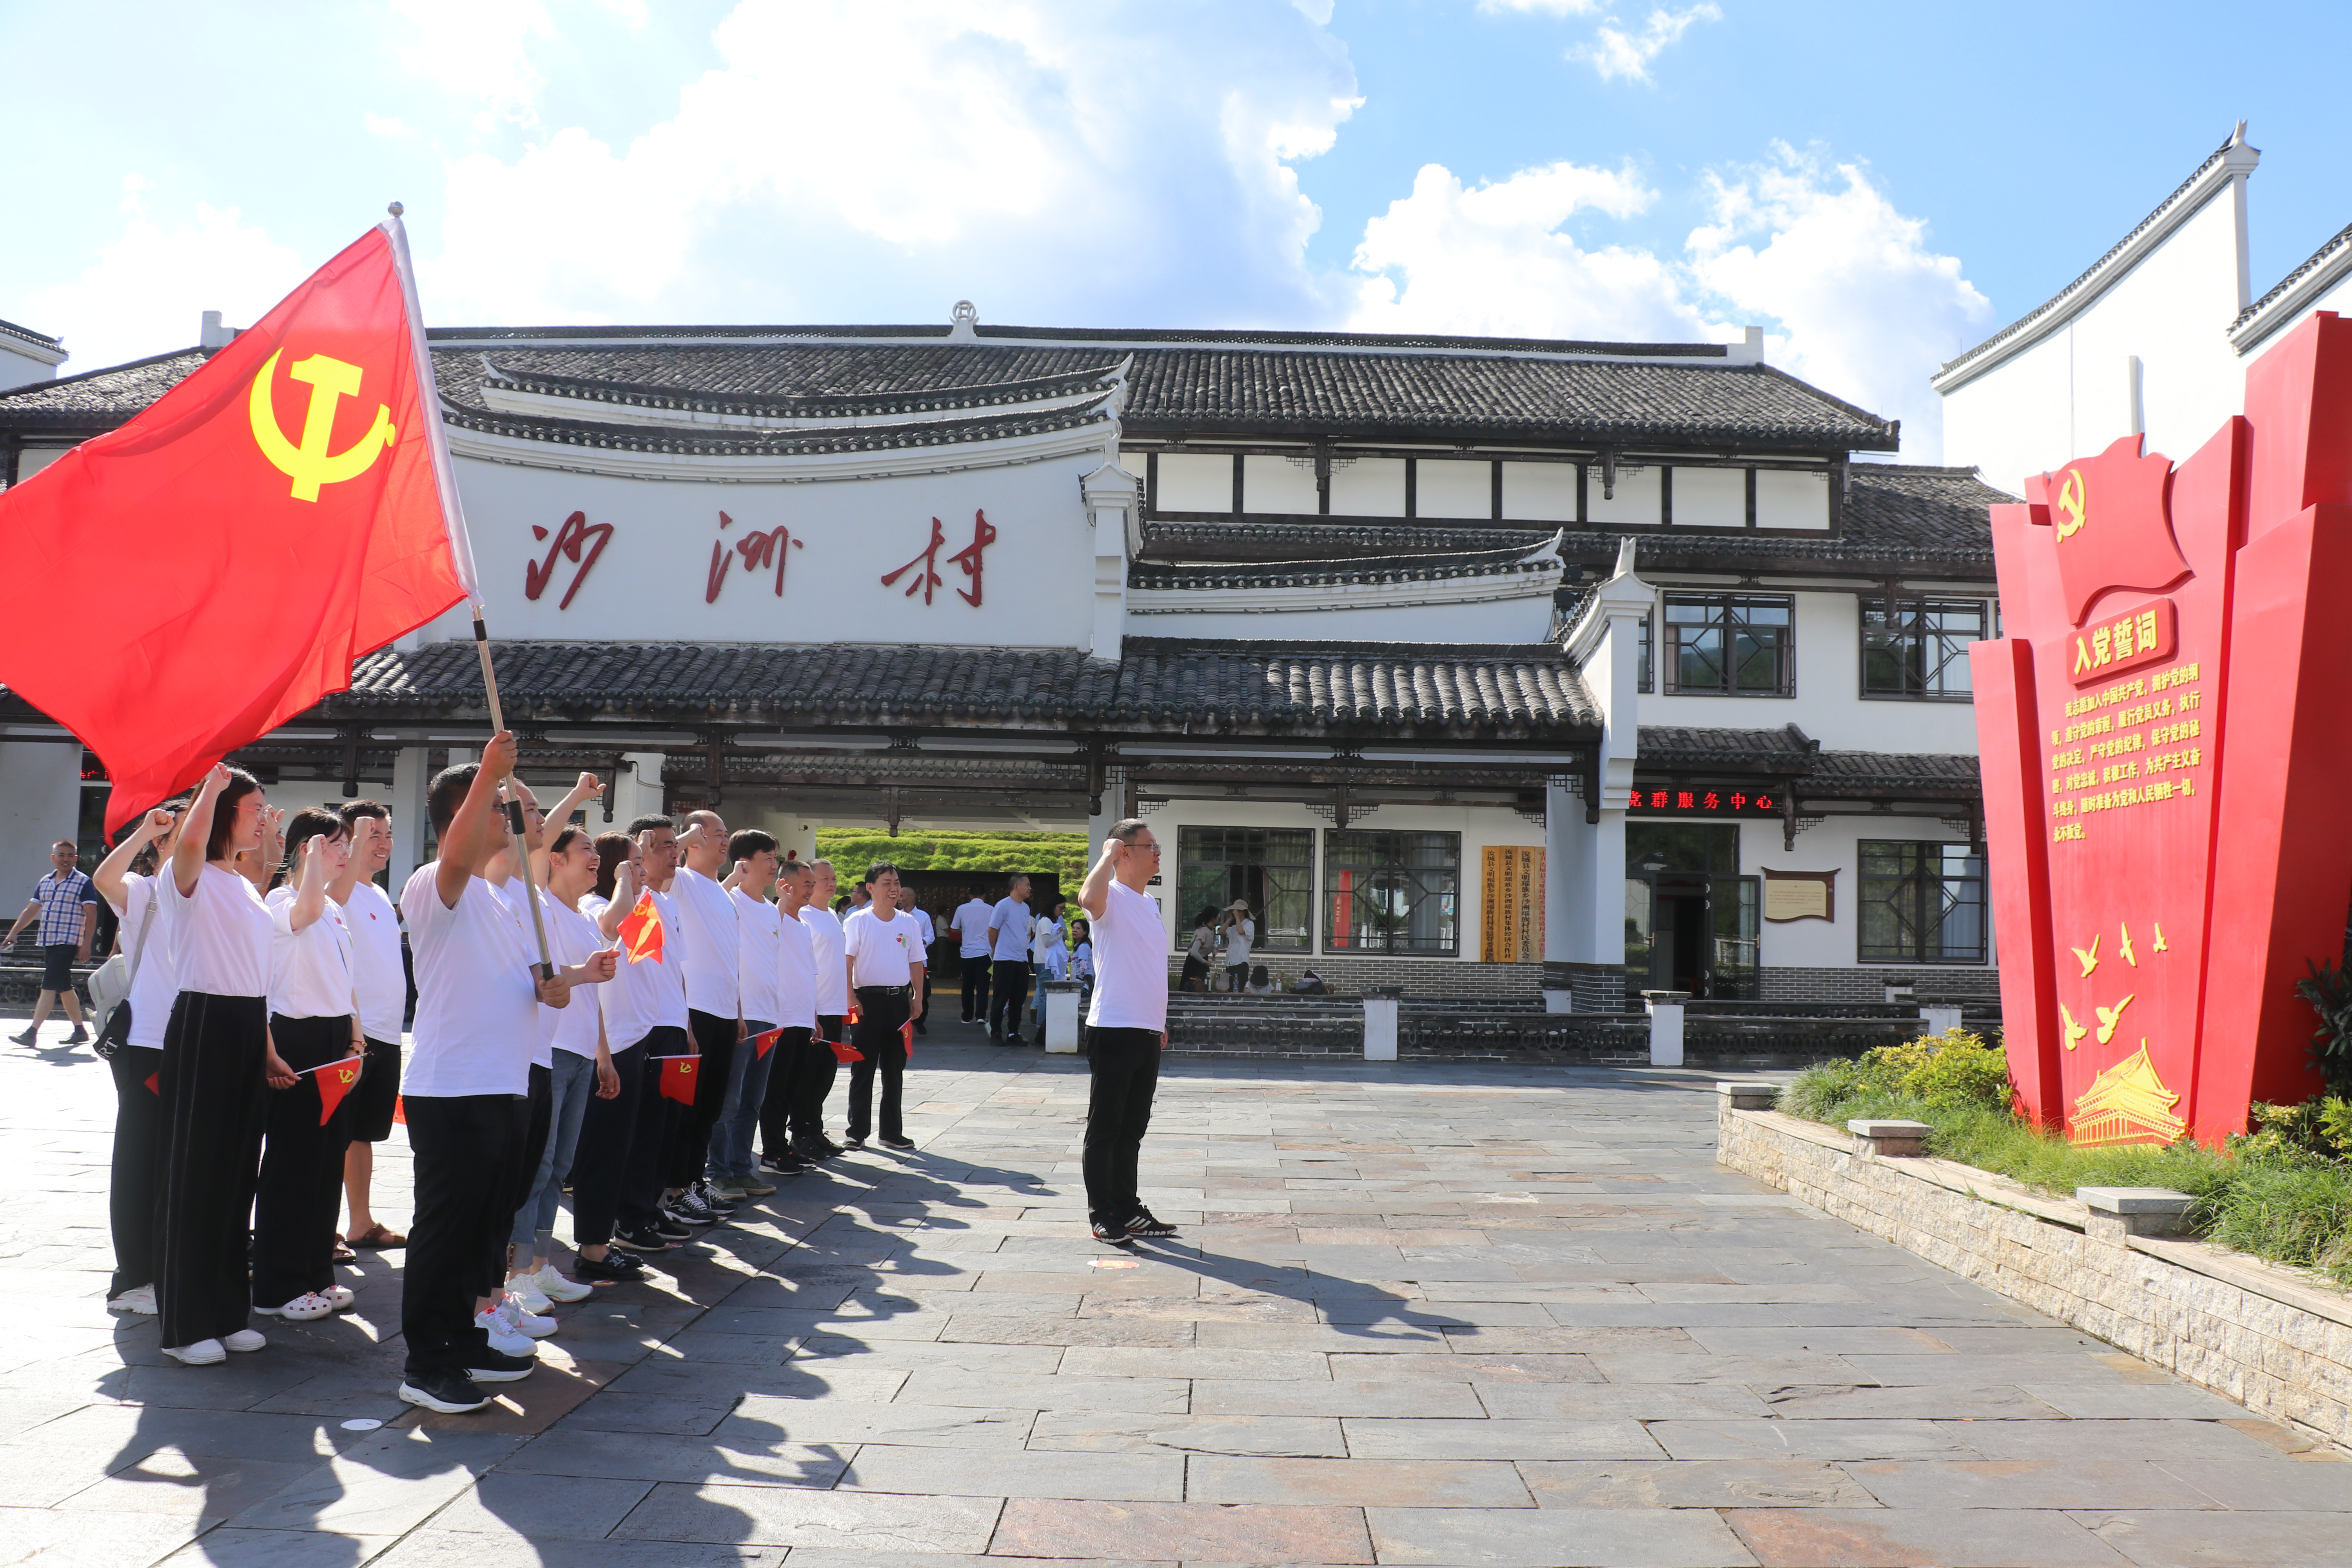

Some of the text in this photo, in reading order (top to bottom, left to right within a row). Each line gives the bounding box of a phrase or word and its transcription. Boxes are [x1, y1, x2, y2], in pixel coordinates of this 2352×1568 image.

[525, 508, 996, 610] 沙洲村
[2074, 610, 2157, 675] 入党誓词
[1629, 791, 1772, 809] 党群服务中心
[2054, 822, 2086, 843] 永不叛党。
[1504, 849, 1513, 958] 汝城县文明瑶族乡沙洲瑶族村集体经济合作社
[1521, 851, 1530, 958] 汝城县文明瑶族乡沙洲瑶族村村民委员会
